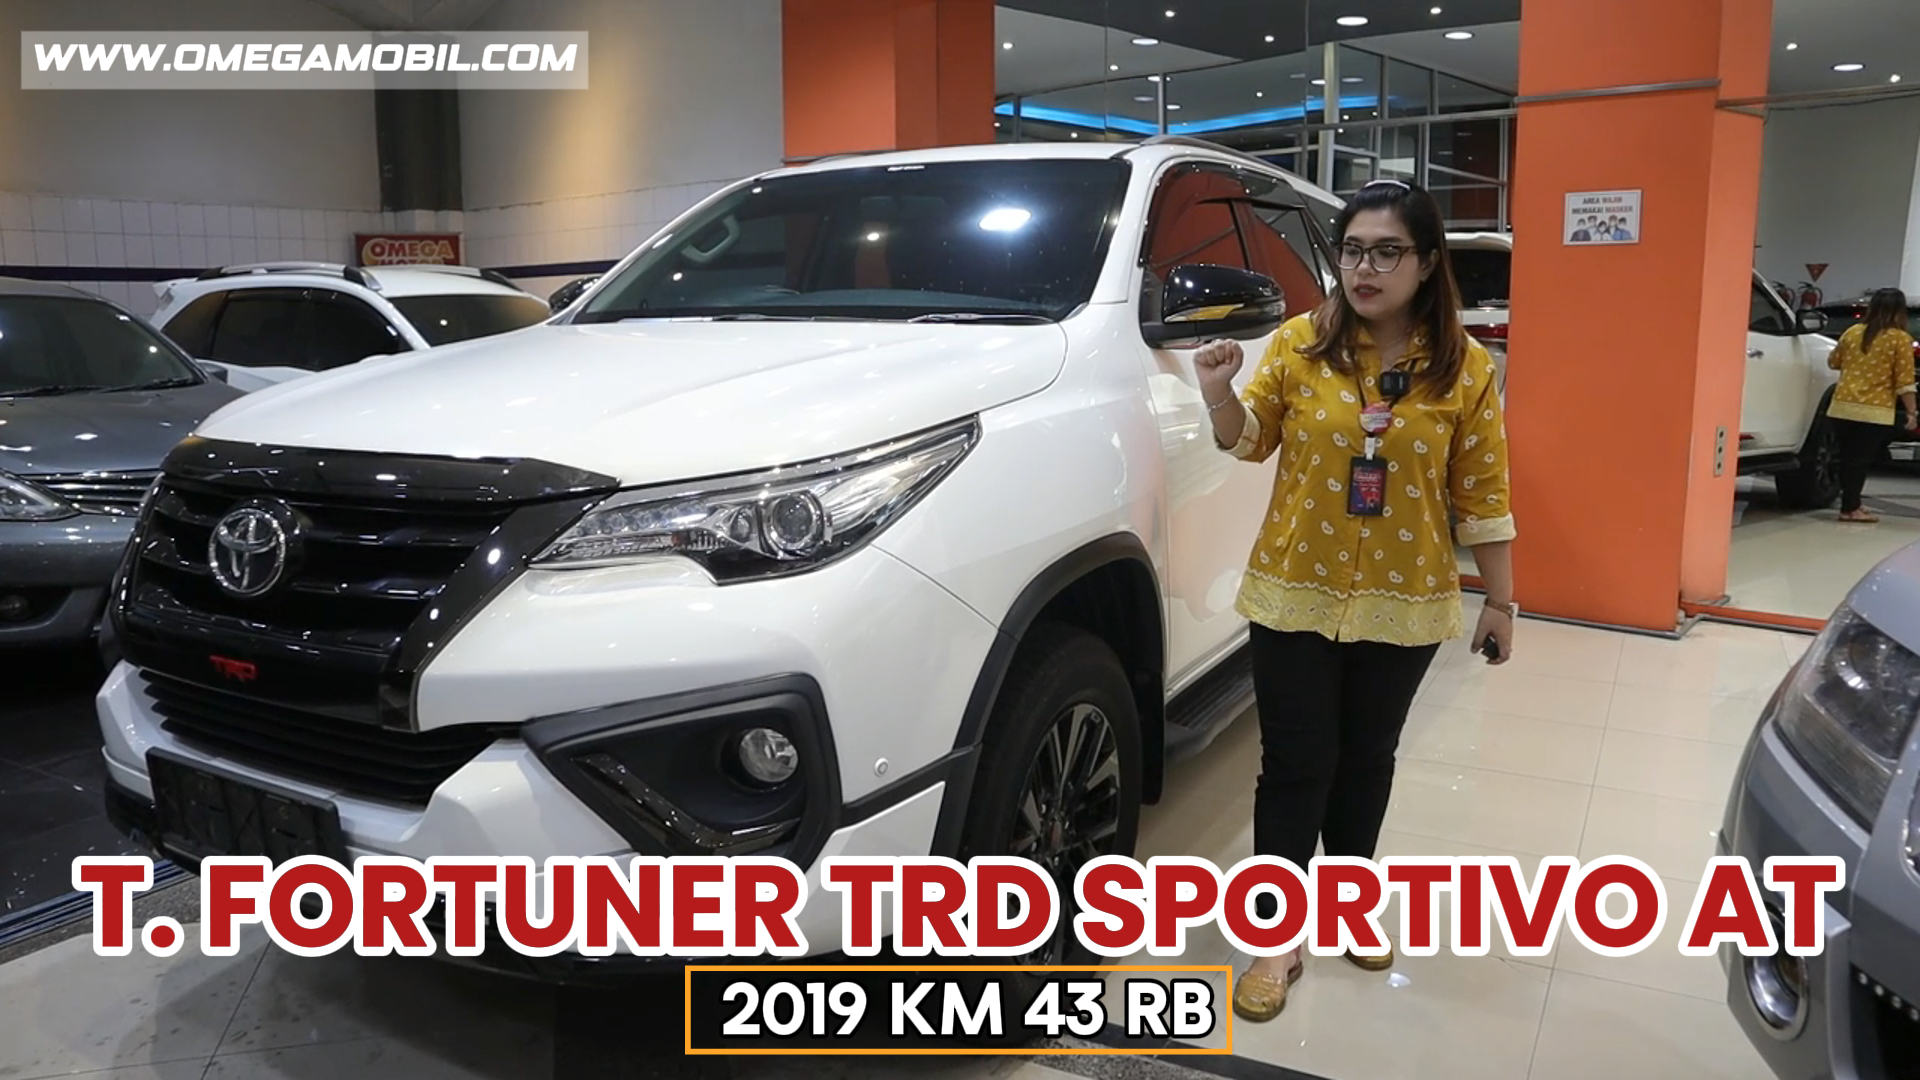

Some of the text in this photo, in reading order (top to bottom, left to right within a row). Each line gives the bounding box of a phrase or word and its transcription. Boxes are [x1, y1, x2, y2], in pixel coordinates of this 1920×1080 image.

[1602, 196, 1622, 204] WAJIB
[1605, 205, 1633, 213] MASKER
[366, 238, 455, 259] OMEGA
[209, 655, 257, 681] TRD
